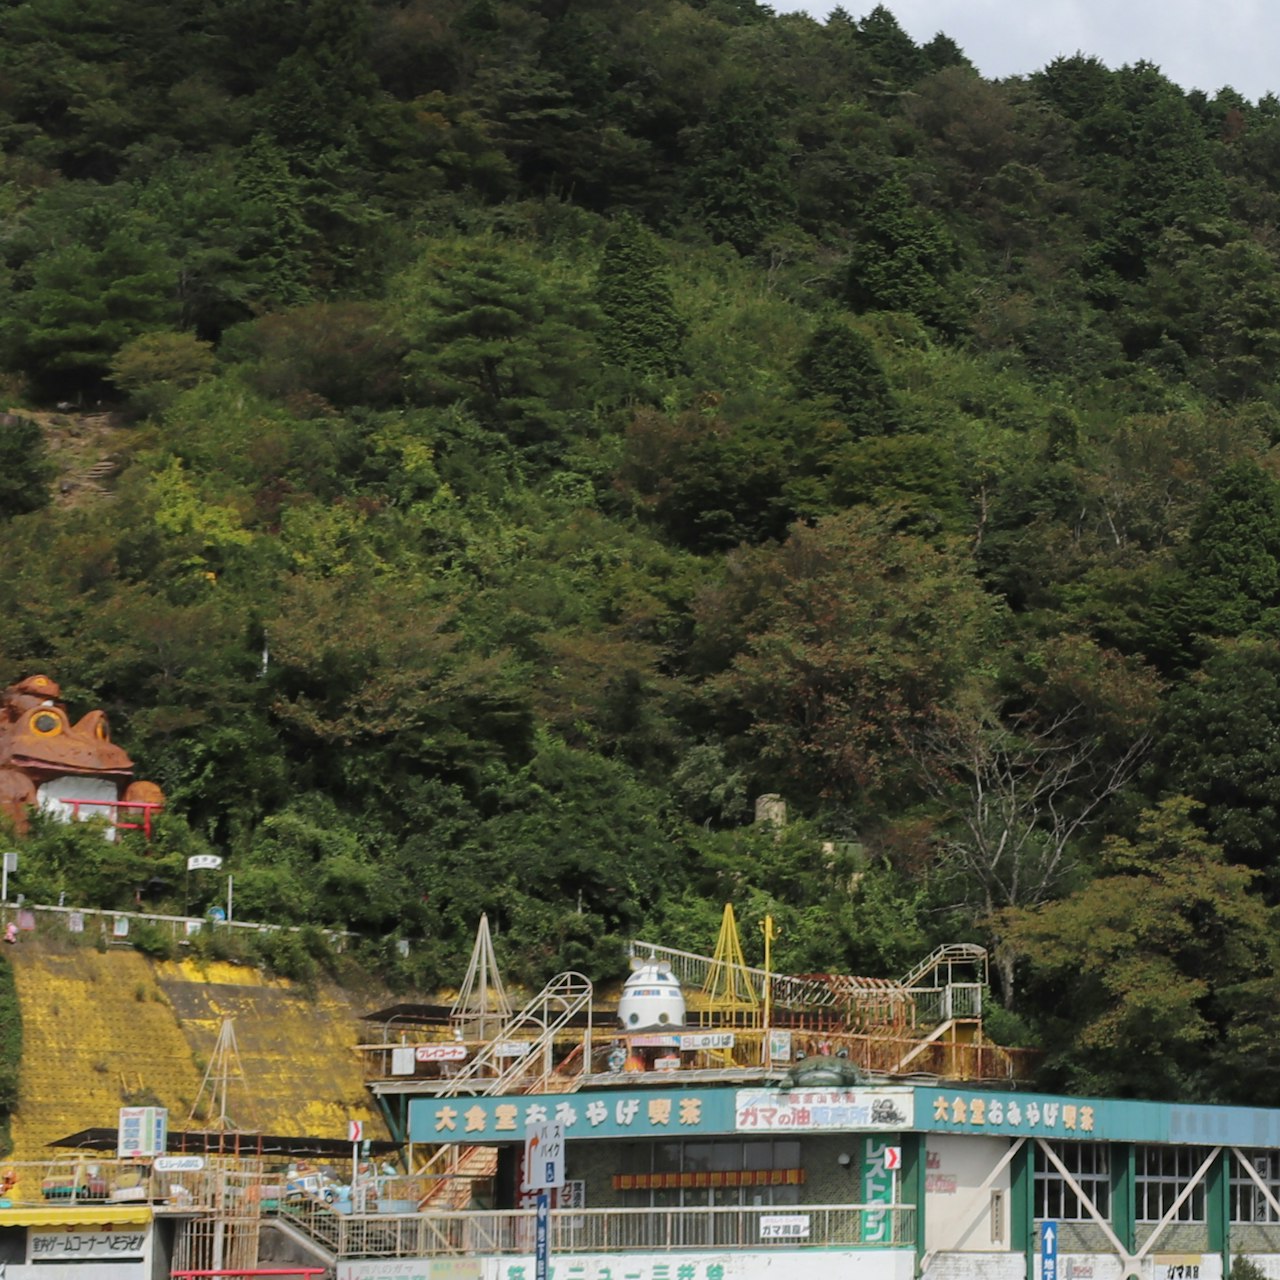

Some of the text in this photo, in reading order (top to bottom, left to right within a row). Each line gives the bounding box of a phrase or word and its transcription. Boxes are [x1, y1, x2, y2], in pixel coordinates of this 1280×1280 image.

[419, 1048, 464, 1058] プレイコーナー
[865, 1138, 887, 1241] レストラン
